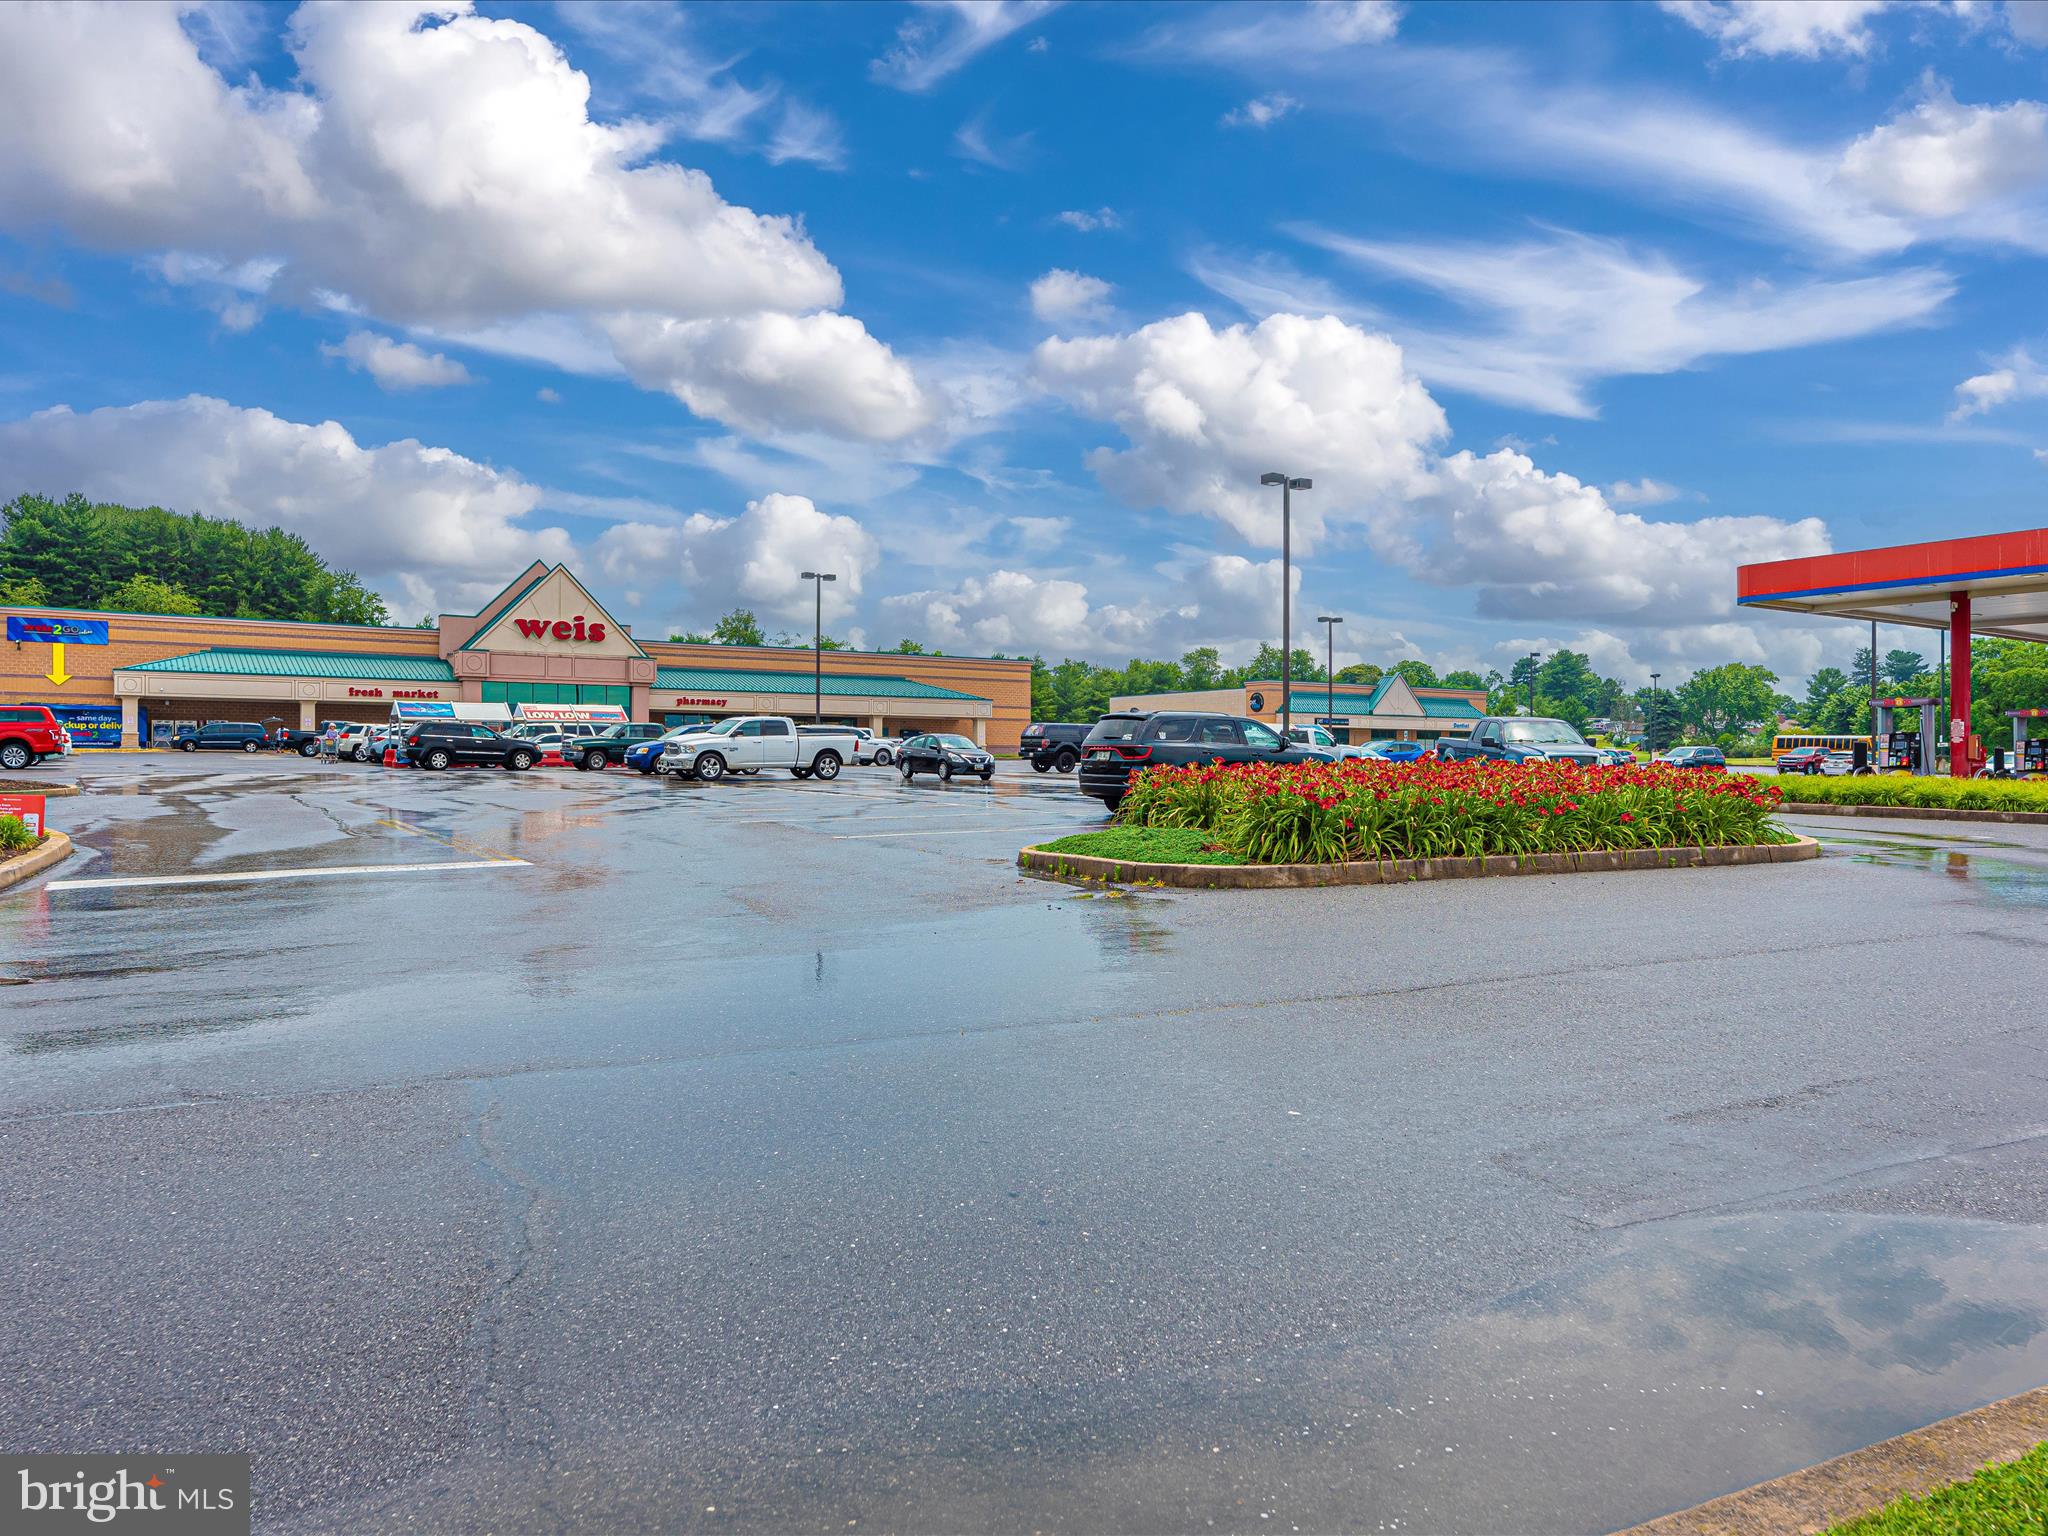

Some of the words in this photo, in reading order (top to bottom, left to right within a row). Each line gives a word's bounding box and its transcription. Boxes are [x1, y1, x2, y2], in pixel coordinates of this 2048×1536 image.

[514, 615, 606, 642] weis
[348, 687, 383, 697] fresh
[392, 689, 439, 699] market
[675, 696, 728, 707] pharmacy
[98, 714, 112, 723] day
[64, 721, 87, 731] ckup
[99, 721, 123, 730] deliv
